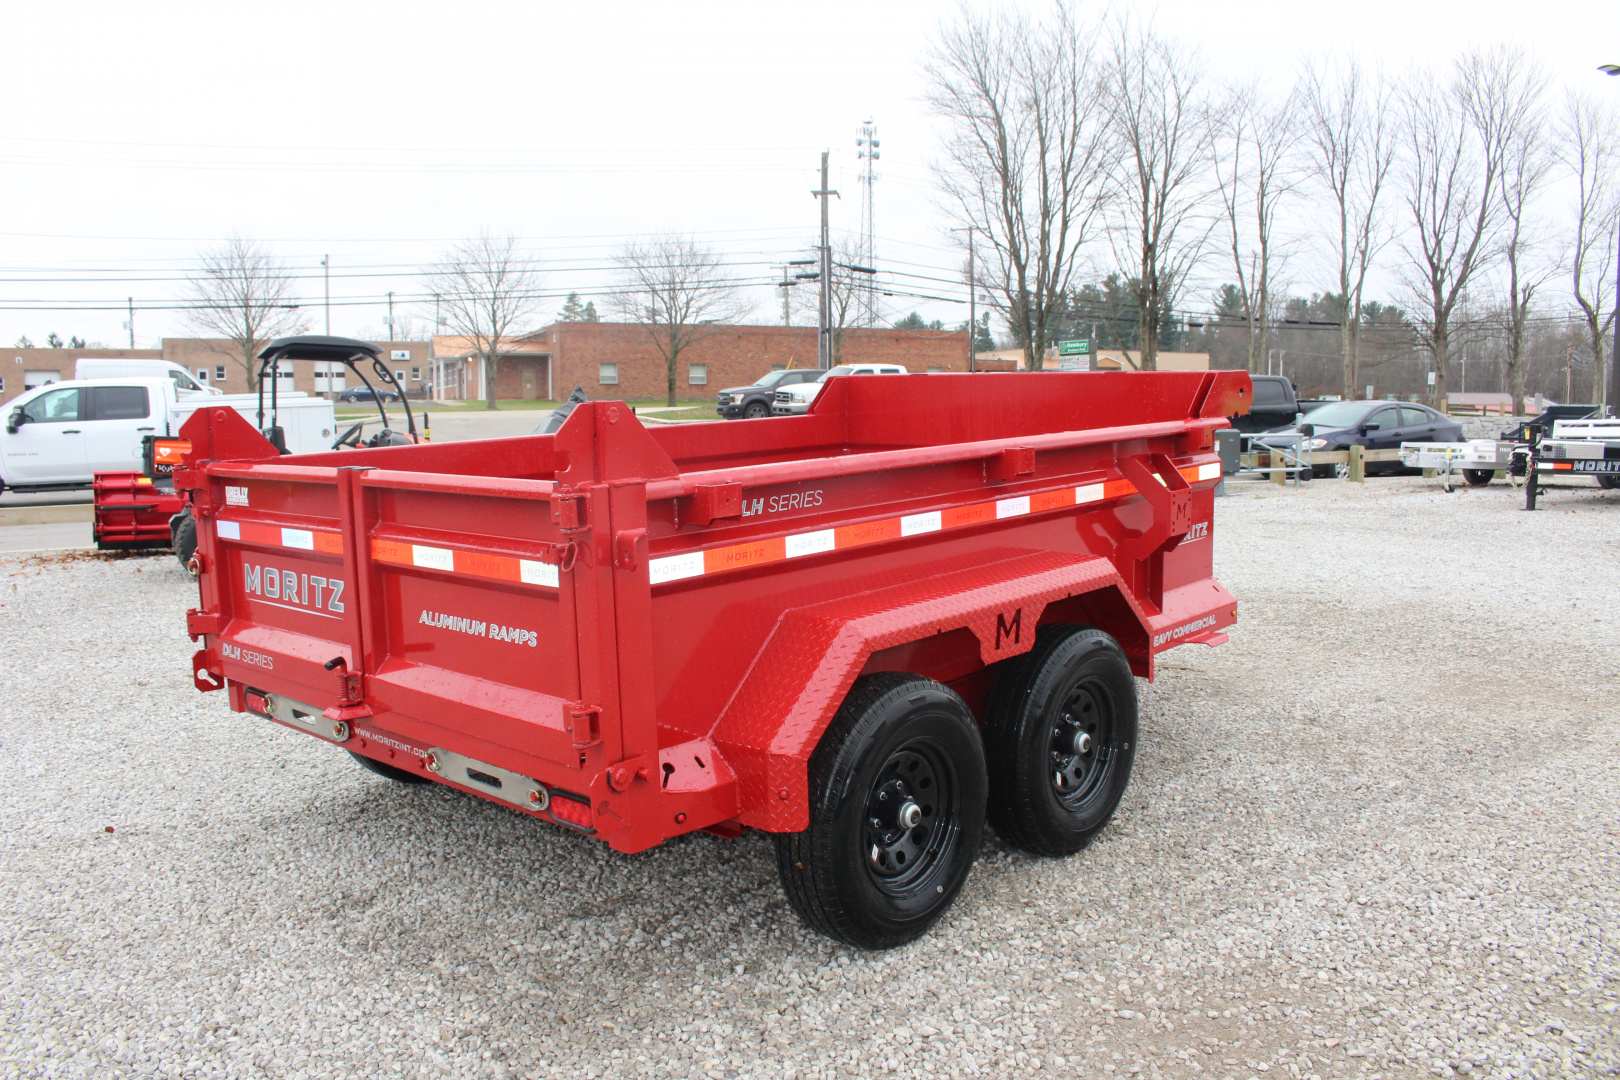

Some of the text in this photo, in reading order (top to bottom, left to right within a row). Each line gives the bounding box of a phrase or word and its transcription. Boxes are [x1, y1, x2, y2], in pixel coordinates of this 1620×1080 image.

[1573, 460, 1620, 471] MORIT
[742, 490, 823, 517] LH SERIES
[1001, 502, 1025, 513] MORITZ
[956, 510, 983, 520] MORITZ
[1176, 502, 1187, 521] M
[907, 518, 936, 529] MORITZ
[853, 528, 883, 539] MORITZ
[325, 539, 342, 549] MORI
[793, 537, 828, 550] MORITZ
[418, 552, 447, 564] MORITZ
[726, 549, 764, 563] MORITZ
[470, 559, 500, 572] MORITZ
[653, 561, 695, 576] MORITZ
[527, 568, 558, 580] MORIT
[244, 563, 344, 613] MORITZ
[419, 610, 537, 648] ALUMINUM RAMPS
[995, 607, 1022, 651] M
[1153, 614, 1217, 648] EAVY COMMERCIAL
[222, 642, 274, 670] DLH SERIES
